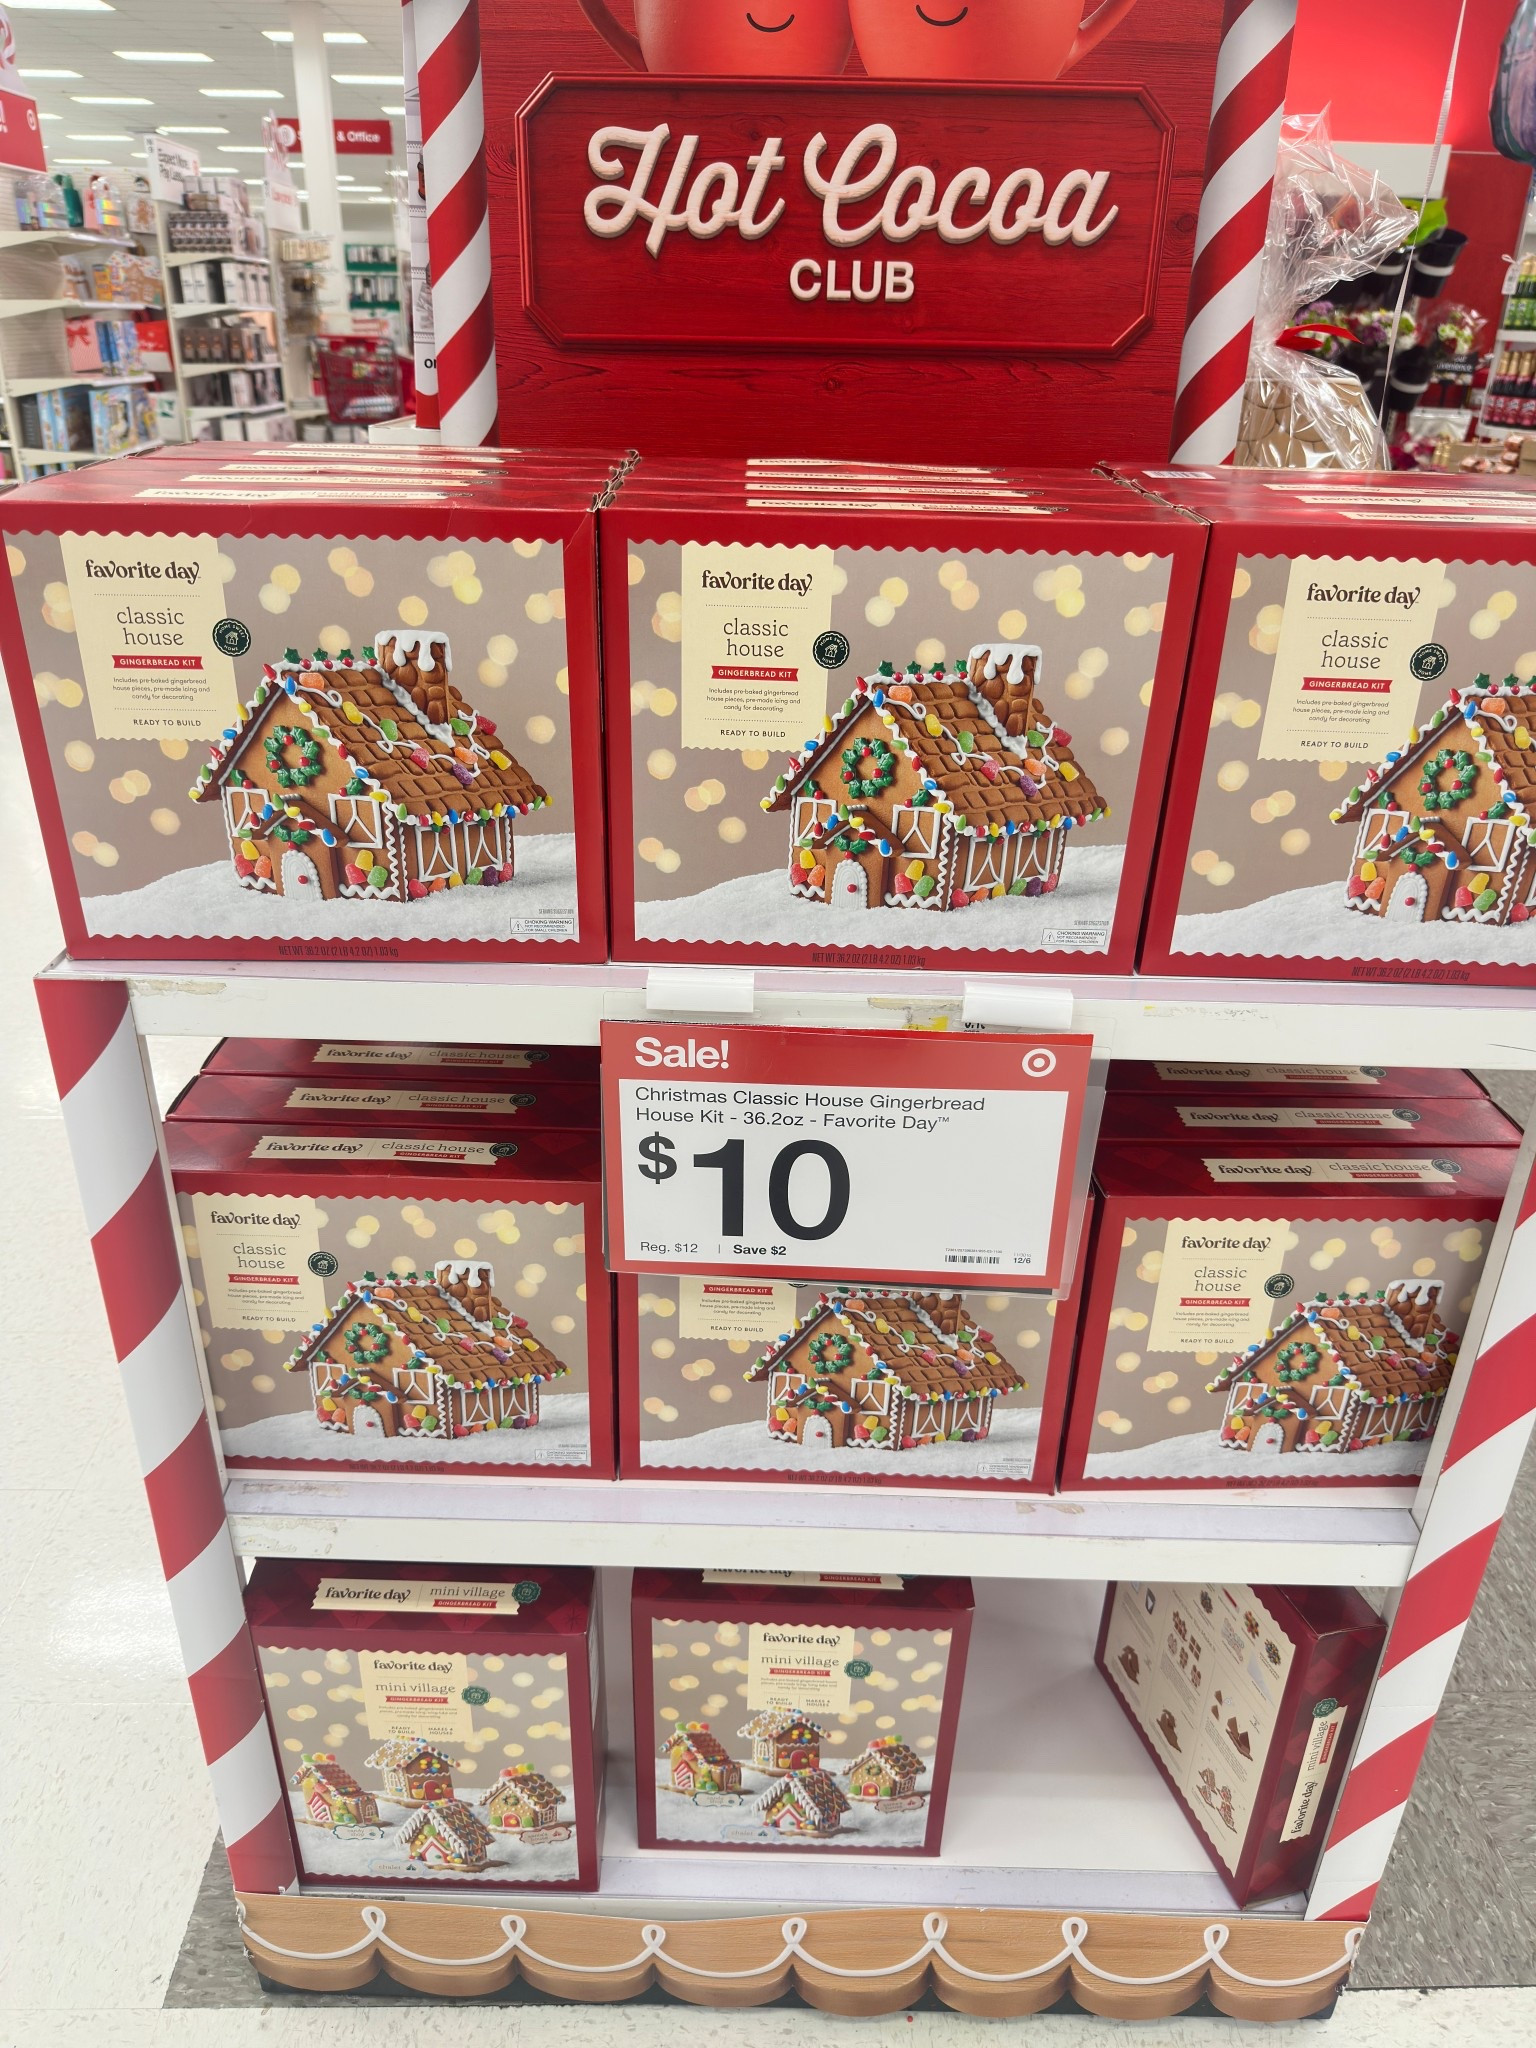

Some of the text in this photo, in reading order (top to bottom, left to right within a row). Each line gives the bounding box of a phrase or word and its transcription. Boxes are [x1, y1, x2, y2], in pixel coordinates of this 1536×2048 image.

[337, 131, 380, 142] & Office
[583, 123, 1119, 259] Hot Cocoa
[789, 258, 915, 302] CLUB
[85, 560, 199, 584] favorite day
[702, 570, 813, 596] favorite day
[1307, 583, 1421, 609] favorite day
[117, 607, 184, 625] classic
[724, 618, 789, 636] classic
[123, 628, 184, 646] house
[1322, 630, 1388, 648] classic
[727, 639, 784, 657] house
[1321, 651, 1381, 669] house
[1309, 681, 1369, 689] GINGERBREAD
[327, 1049, 520, 1060] favorite day classic house
[635, 1037, 729, 1069] Sale!
[1166, 1067, 1222, 1076] favorite
[1225, 1069, 1251, 1077] day
[300, 1094, 505, 1105] favorite day classic house
[636, 1087, 985, 1112] Christmas Classic House Gingerbread
[636, 1108, 693, 1122] House
[700, 1110, 724, 1123] Kit
[744, 1112, 803, 1126] 36.2oz
[824, 1114, 896, 1129] Favorite
[1190, 1112, 1249, 1121] favorite
[1252, 1113, 1278, 1122] day
[266, 1142, 485, 1153] favorite day classic house
[1218, 1163, 1430, 1176] favorite day classic house
[638, 1131, 850, 1240] $10
[211, 1211, 300, 1229] favorite day
[234, 1243, 286, 1256] classic
[641, 1242, 786, 1256] Reg. $12 Save $2
[1182, 1236, 1271, 1252] favorite day
[238, 1256, 285, 1269] house
[1195, 1267, 1247, 1278] classic
[1194, 1280, 1241, 1292] house
[326, 1586, 505, 1603] favorite day mini village
[763, 1632, 840, 1647] favorite day
[374, 1660, 452, 1673] favorite day
[761, 1655, 839, 1668] mini village
[376, 1682, 456, 1695] mini village
[1291, 1721, 1328, 1834] favorite day mini village
